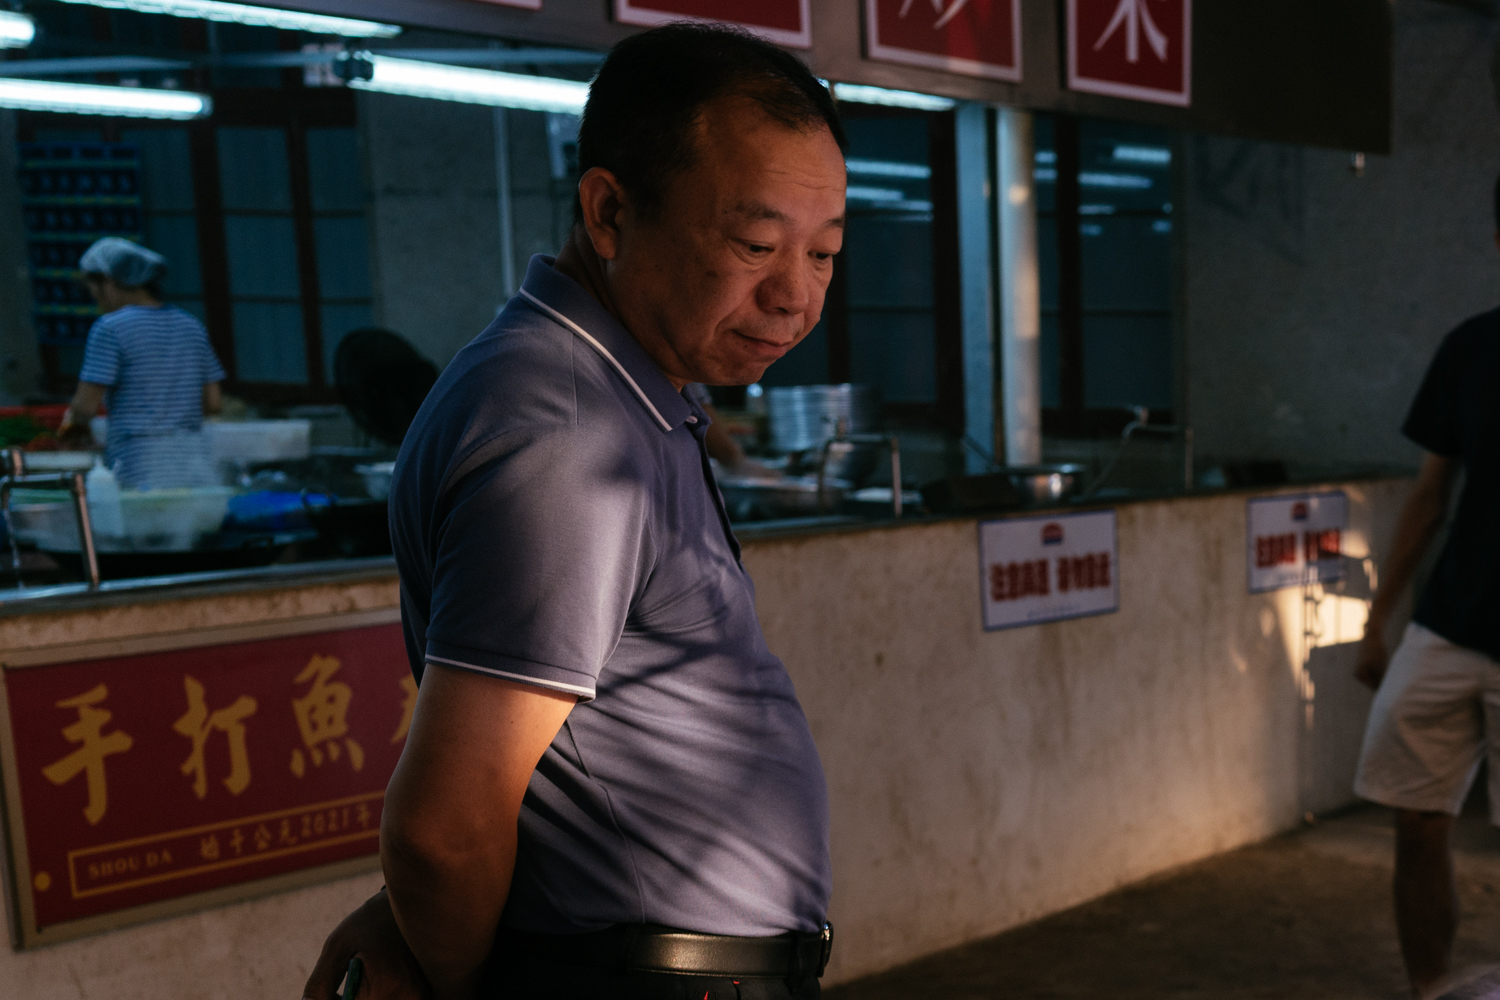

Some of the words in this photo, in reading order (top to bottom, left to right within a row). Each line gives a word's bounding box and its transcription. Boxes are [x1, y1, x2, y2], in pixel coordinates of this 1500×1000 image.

[42, 653, 418, 826] 手打魚
[88, 854, 140, 880] SHOU
[146, 849, 172, 869] DA
